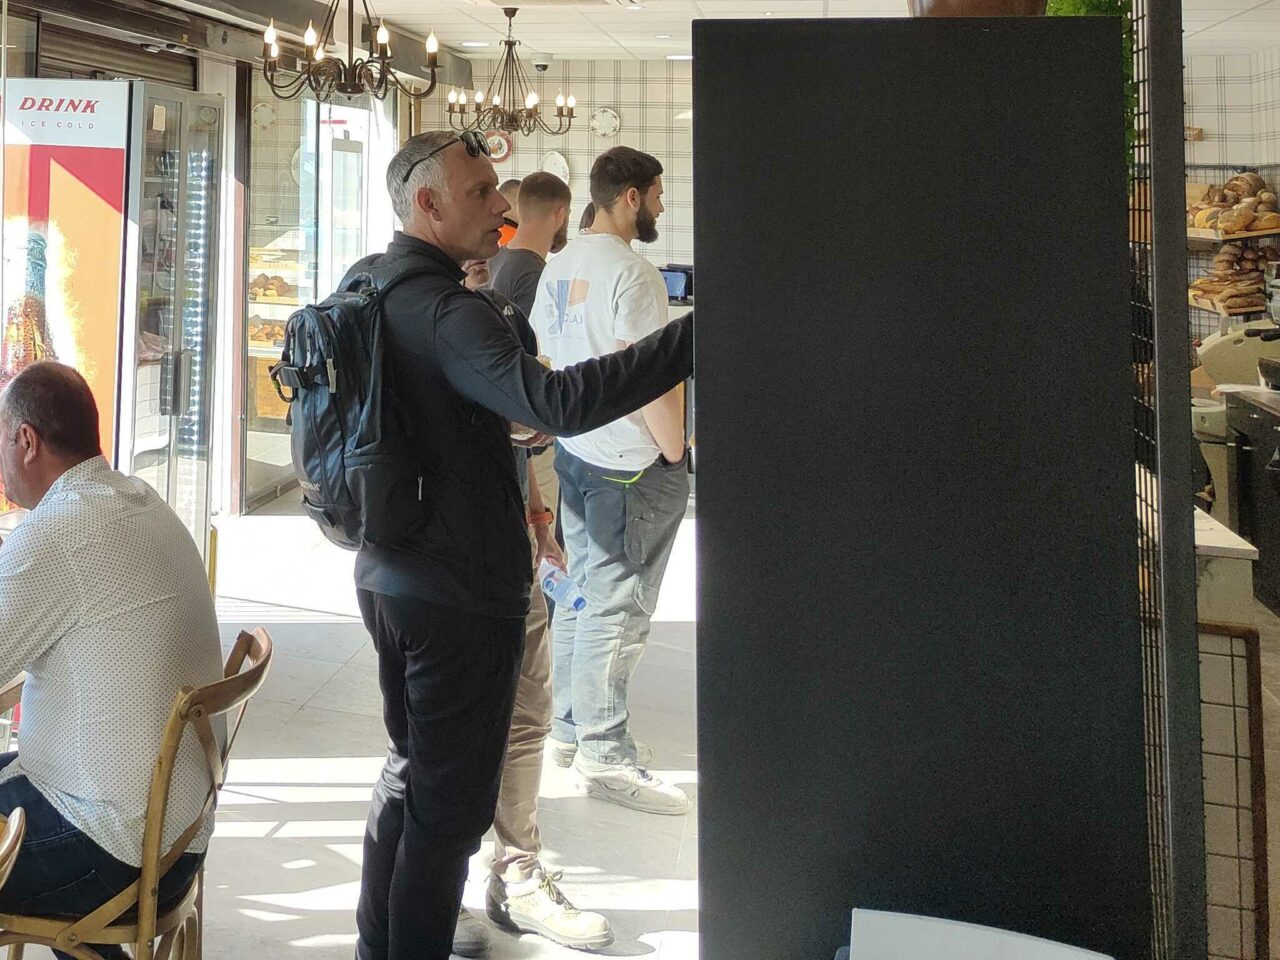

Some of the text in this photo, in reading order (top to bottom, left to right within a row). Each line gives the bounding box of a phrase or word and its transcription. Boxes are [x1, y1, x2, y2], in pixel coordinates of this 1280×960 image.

[18, 97, 100, 114] DRINK
[21, 120, 95, 130] ICE COLD
